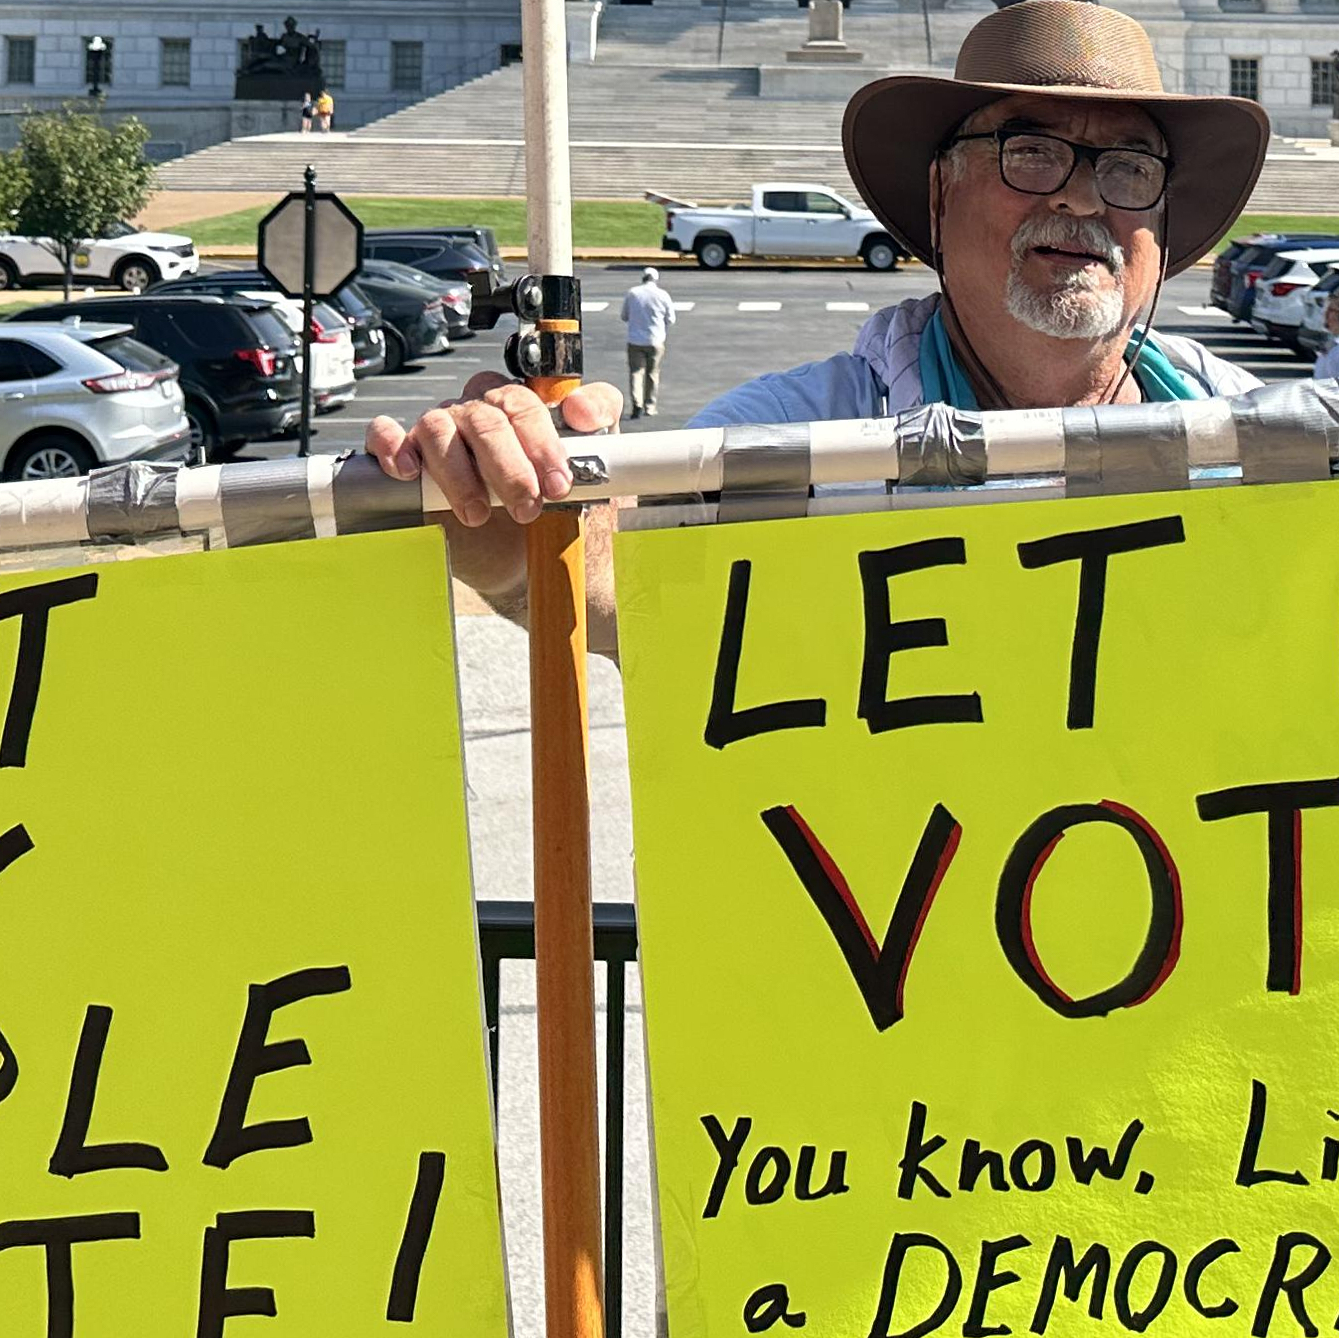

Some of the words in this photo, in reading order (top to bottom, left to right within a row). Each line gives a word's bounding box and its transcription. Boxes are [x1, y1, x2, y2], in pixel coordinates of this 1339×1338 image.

[704, 514, 1185, 749] LET
[700, 1114, 850, 1219] You
[742, 1282, 807, 1335] a
